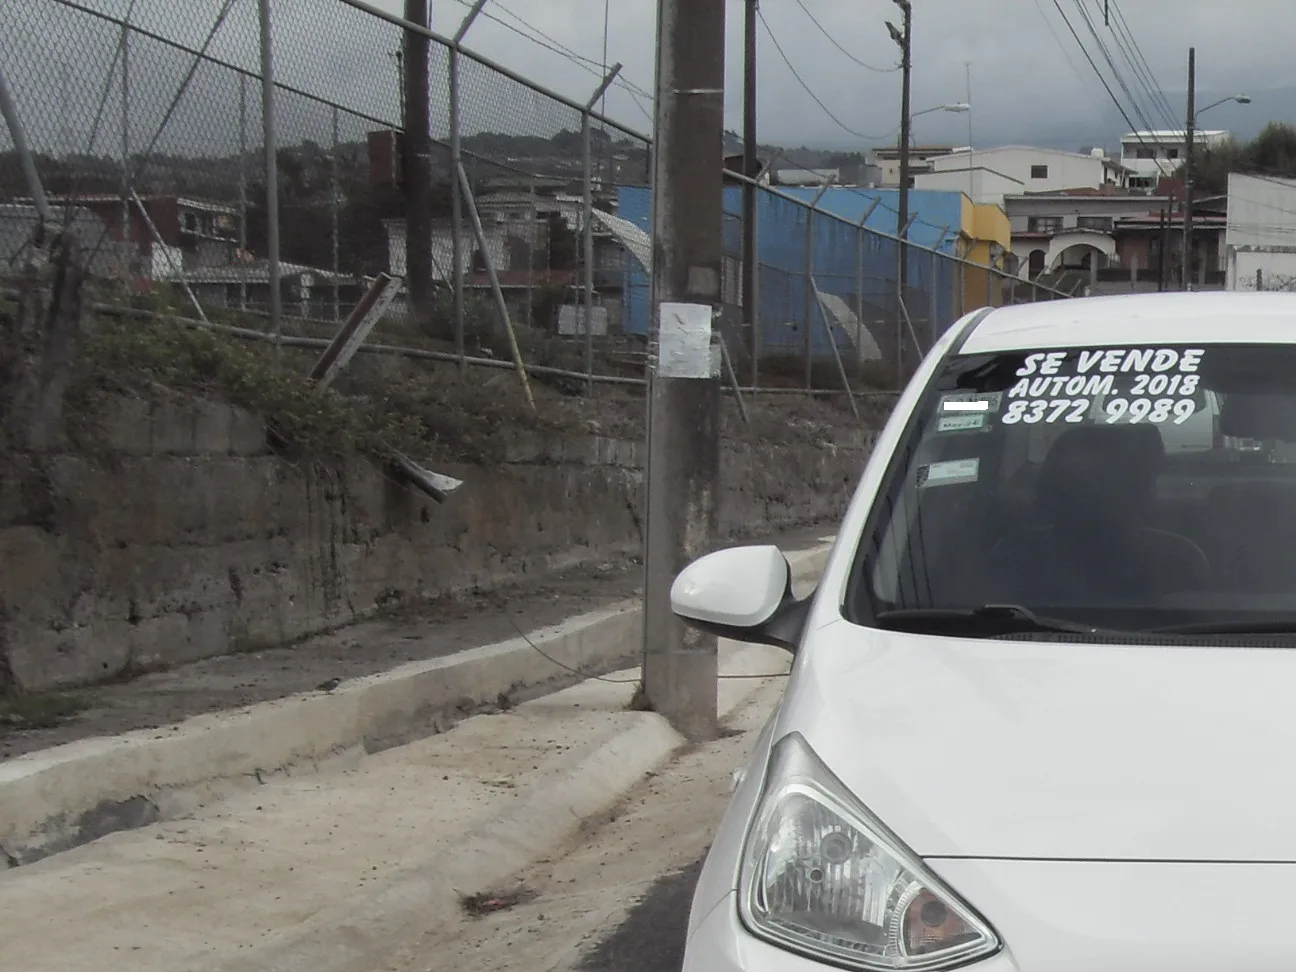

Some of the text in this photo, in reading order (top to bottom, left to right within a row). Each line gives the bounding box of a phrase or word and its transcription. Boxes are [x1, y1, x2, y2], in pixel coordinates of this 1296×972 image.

[1016, 349, 1205, 376] SE VENDE
[1008, 374, 1200, 397] AUTOM. 2018
[1002, 398, 1090, 424] 8372
[1105, 398, 1196, 424] 9989
